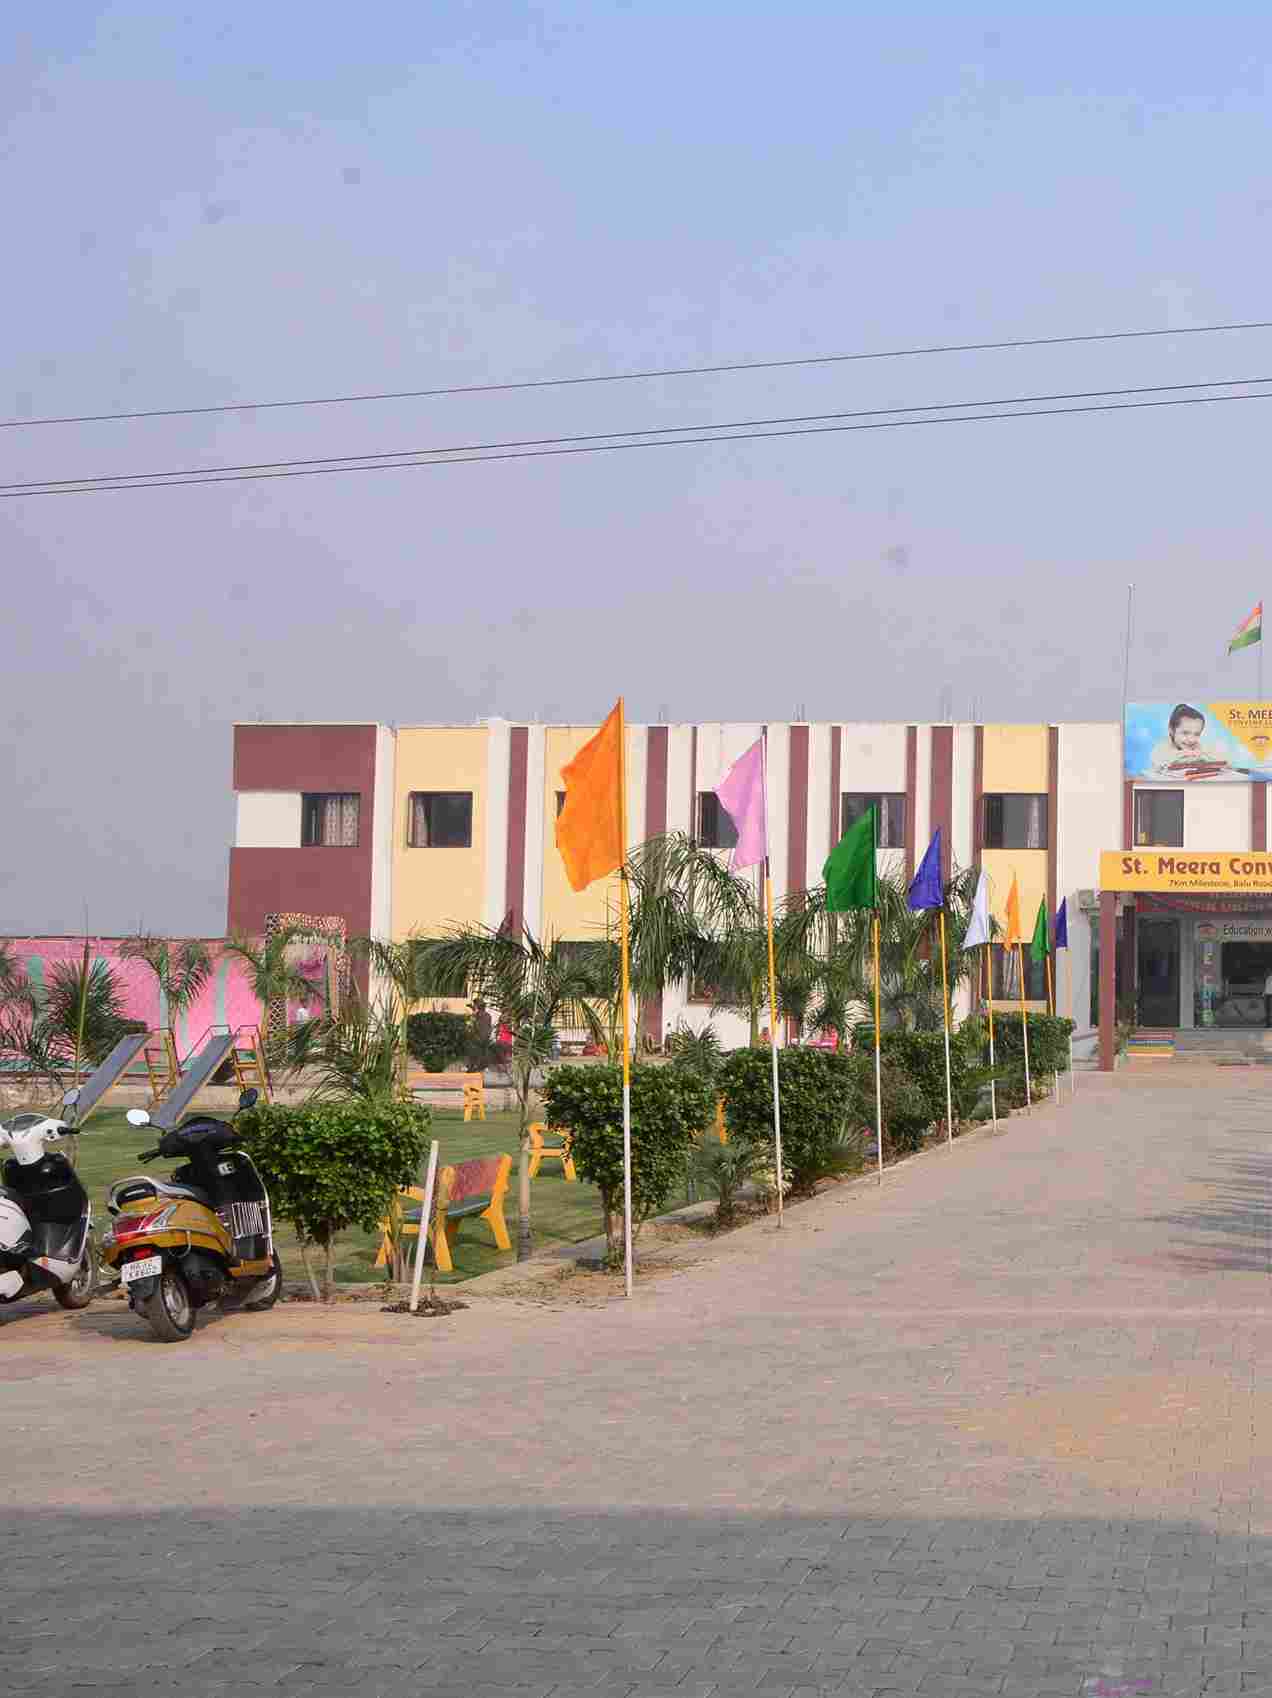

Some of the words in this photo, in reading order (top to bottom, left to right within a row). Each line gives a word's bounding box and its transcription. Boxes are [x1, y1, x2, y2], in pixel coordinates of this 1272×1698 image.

[1229, 708, 1245, 720] St.
[1121, 857, 1148, 875] St.
[1158, 857, 1221, 875] Meera
